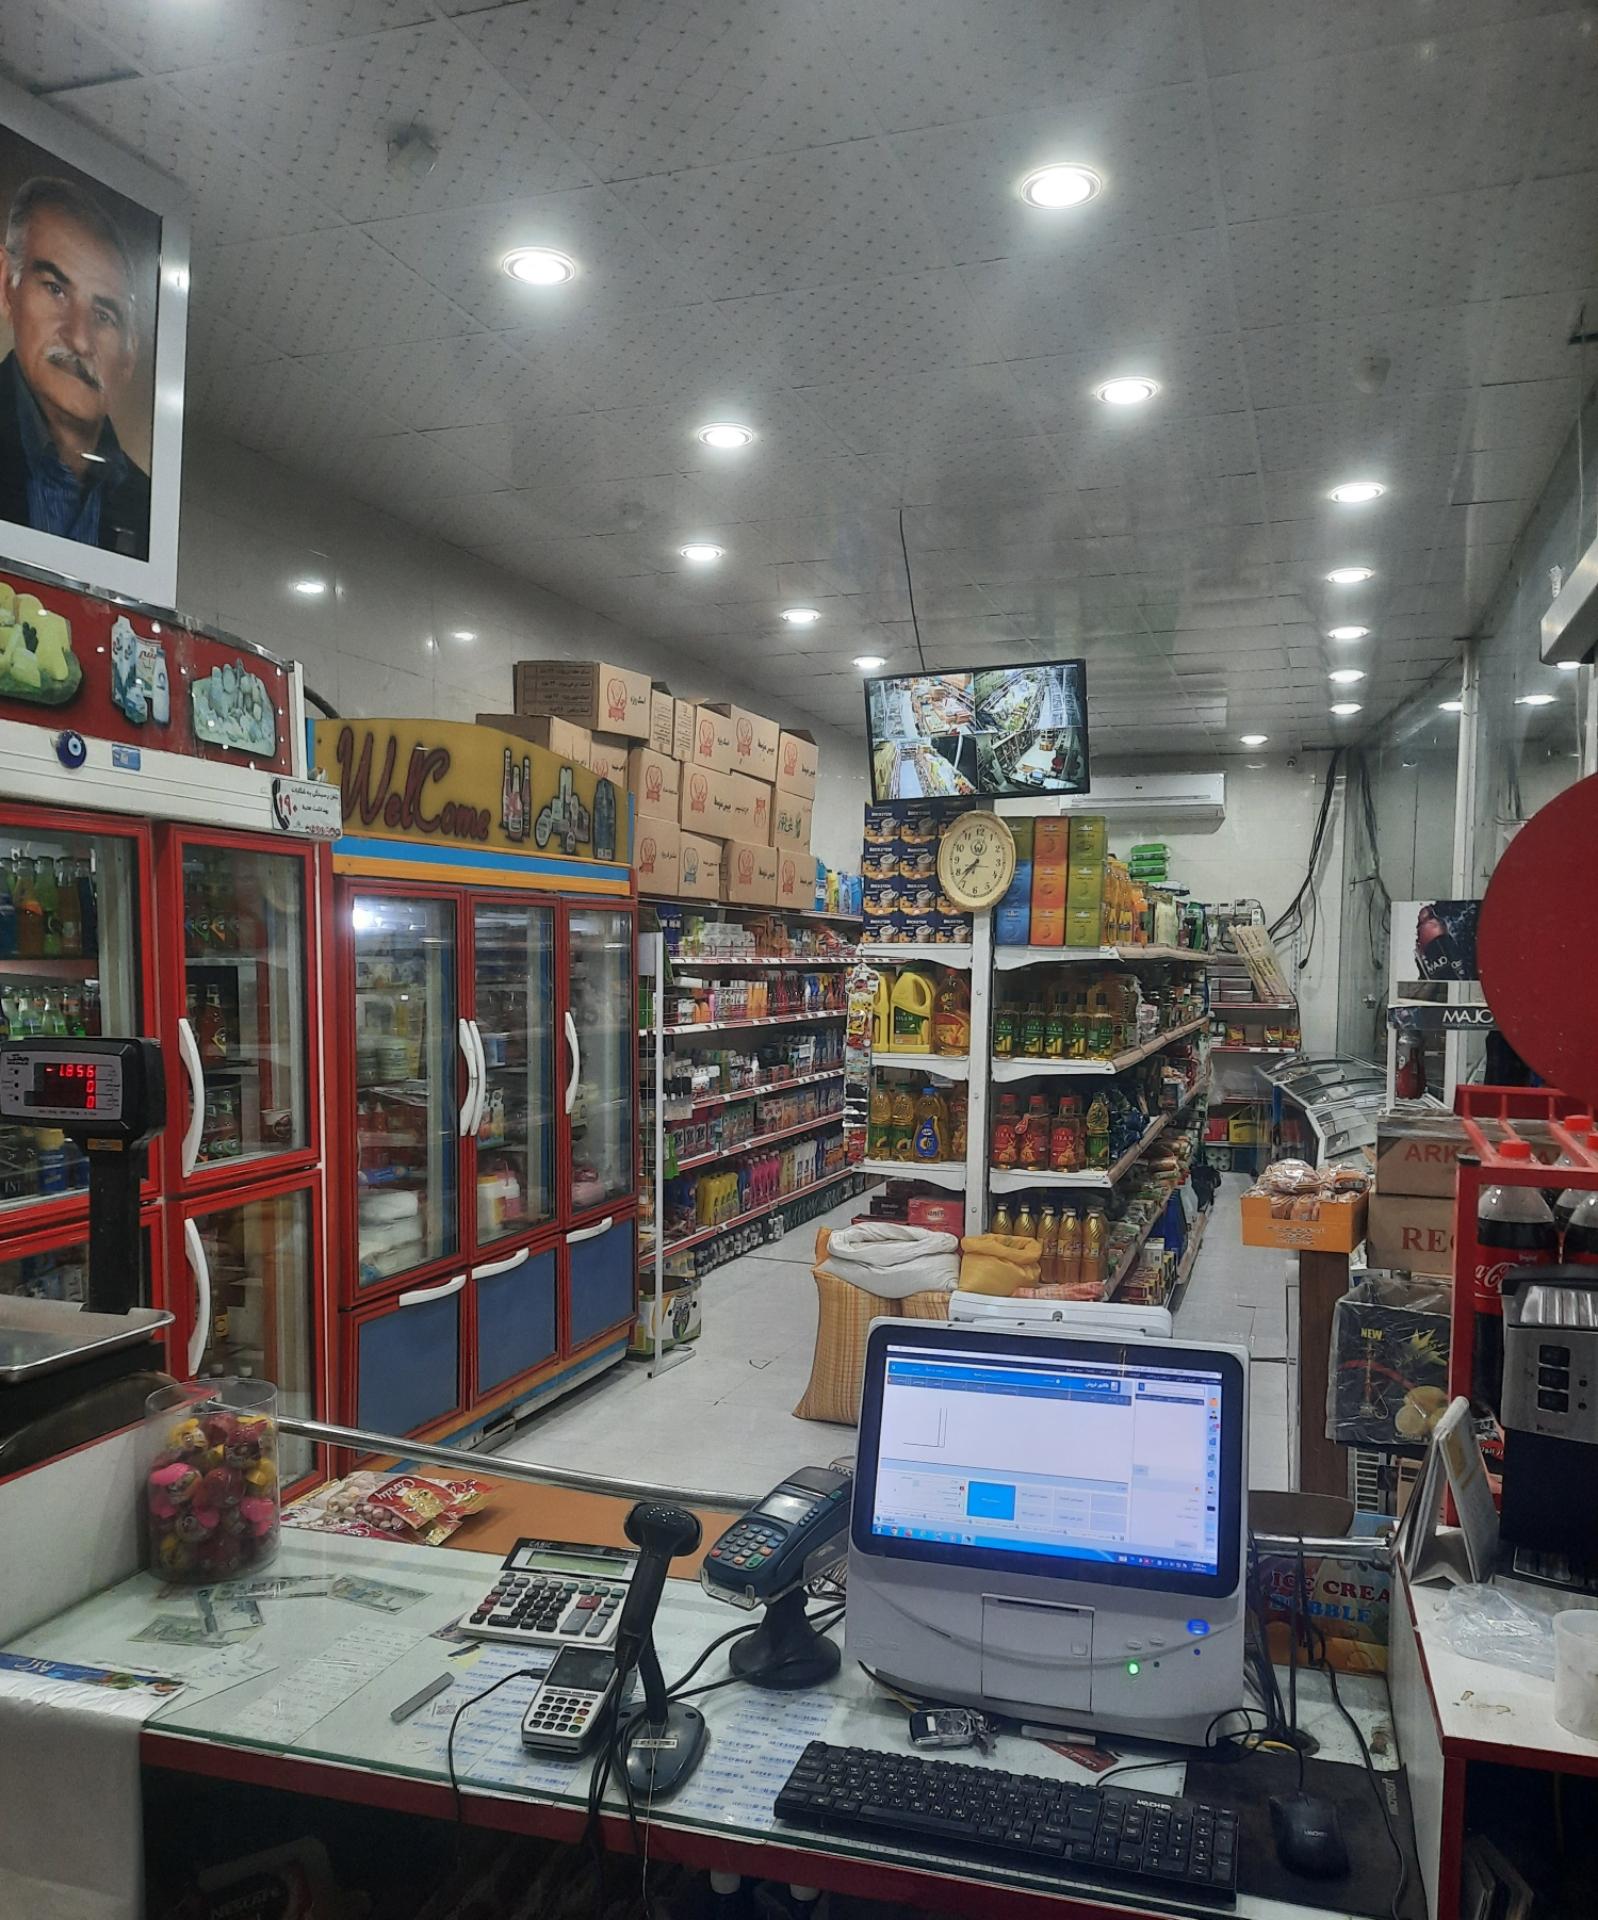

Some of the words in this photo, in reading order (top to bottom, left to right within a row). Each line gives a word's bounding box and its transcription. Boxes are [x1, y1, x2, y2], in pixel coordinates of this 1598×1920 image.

[1401, 1226, 1456, 1253] RE
[1361, 1327, 1383, 1341] NEW
[375, 1478, 415, 1501] Candy
